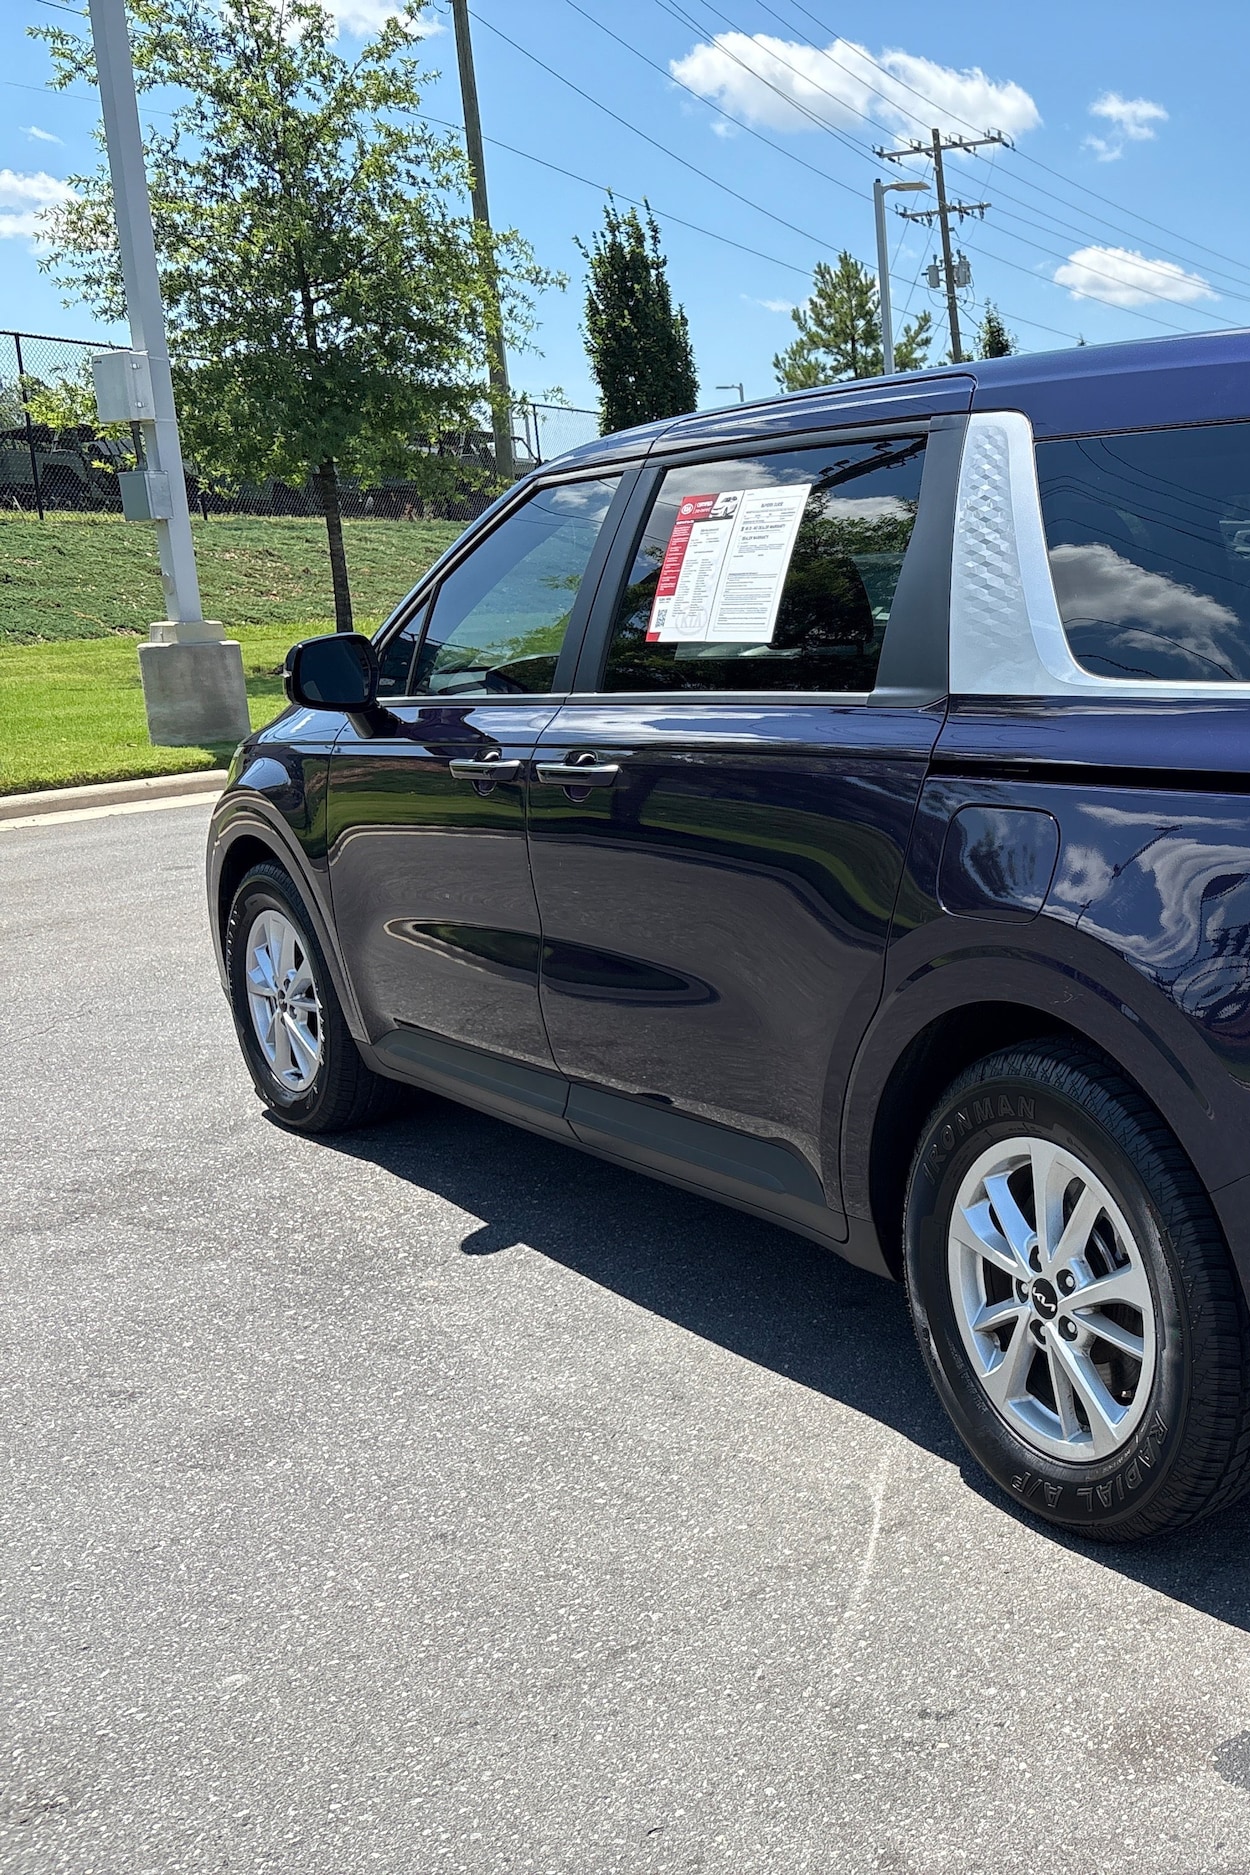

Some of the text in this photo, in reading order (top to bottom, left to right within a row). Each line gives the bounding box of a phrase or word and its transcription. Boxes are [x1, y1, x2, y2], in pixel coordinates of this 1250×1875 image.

[923, 1094, 1037, 1184] IRONMAN
[1010, 1410, 1168, 1512] RADIAL A/P
